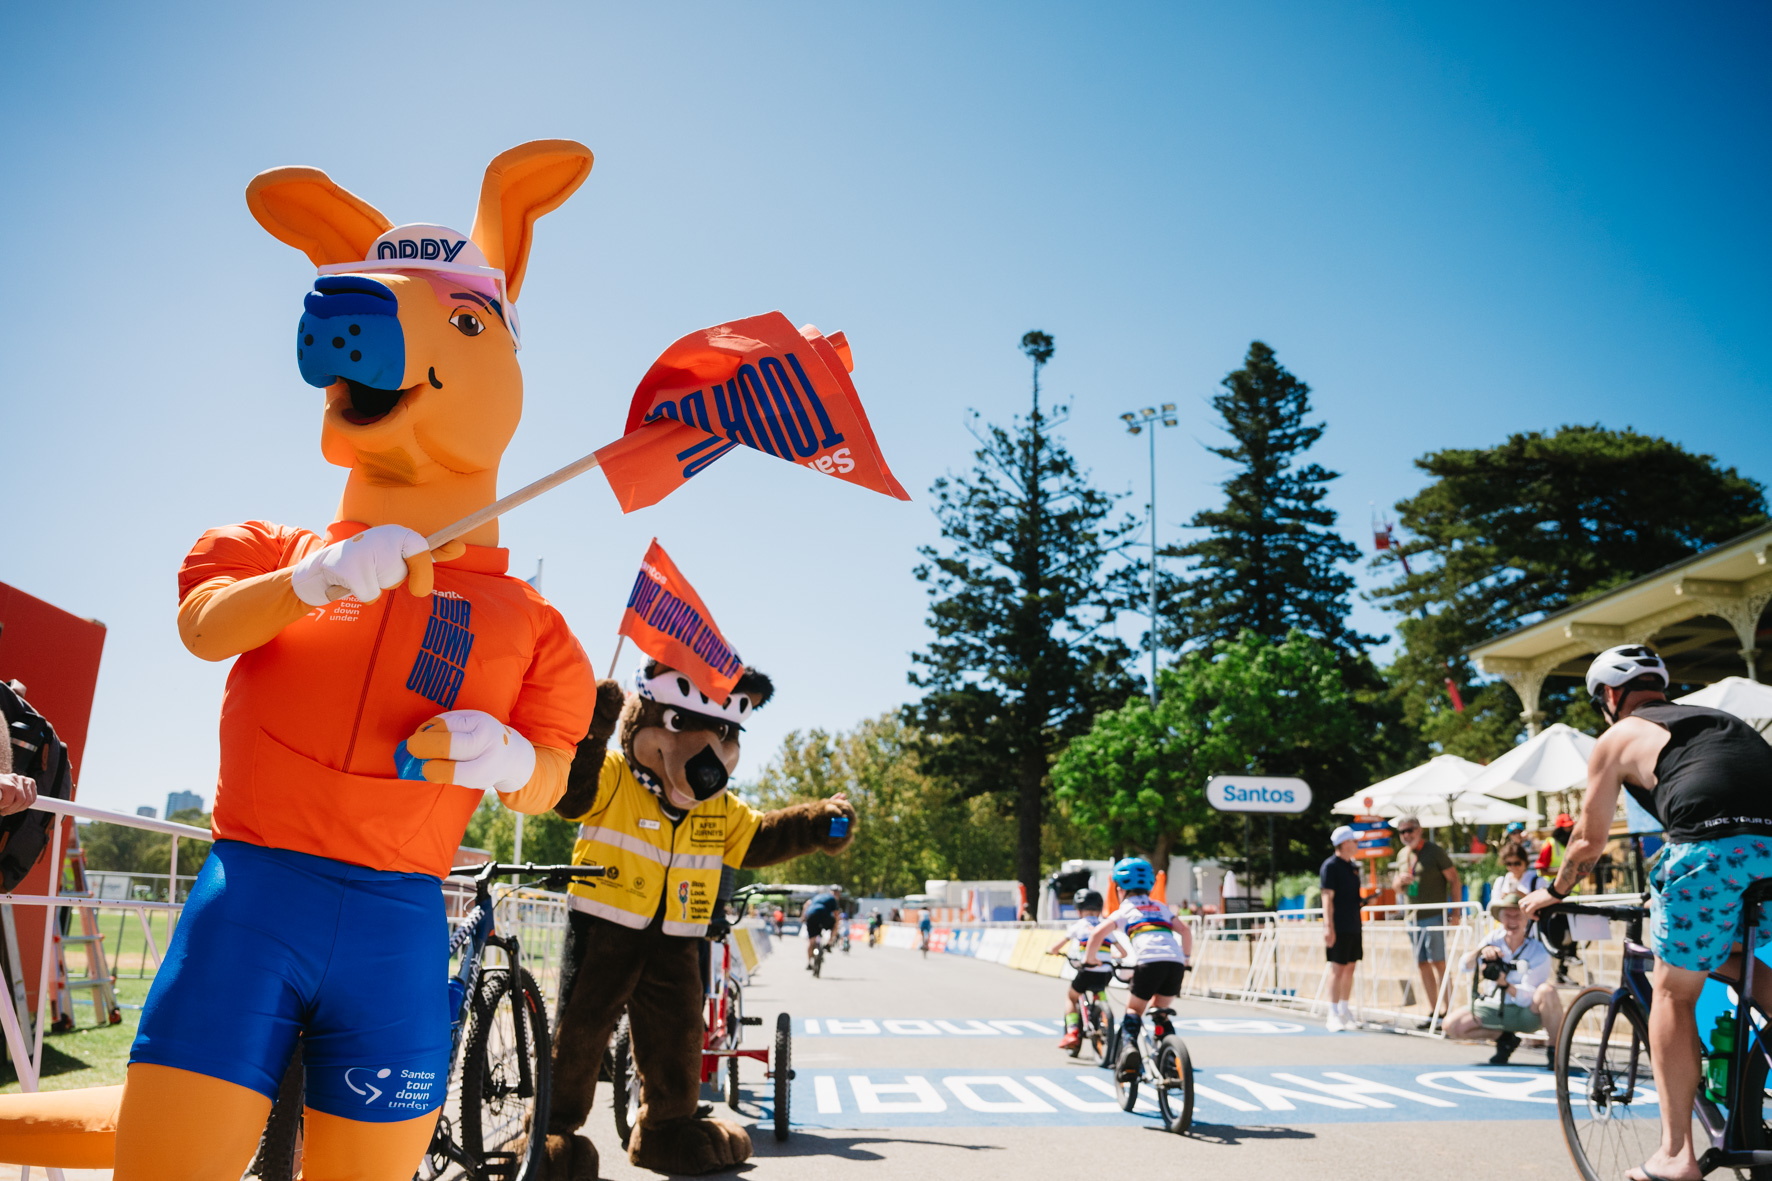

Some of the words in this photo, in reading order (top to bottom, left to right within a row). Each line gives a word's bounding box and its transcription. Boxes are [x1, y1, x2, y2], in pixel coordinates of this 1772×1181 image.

[340, 601, 363, 609] tour
[333, 607, 360, 616] down
[433, 594, 472, 630] TOUR
[329, 614, 358, 622] under
[648, 590, 704, 647] DOWN
[693, 624, 740, 680] UNDER
[421, 615, 475, 669] DOWN
[406, 649, 465, 711] UNDER
[1223, 784, 1295, 804] Santos
[1704, 817, 1730, 828] RIDE
[1732, 815, 1763, 825] YOUR
[463, 953, 481, 1012] POLICE
[400, 1069, 436, 1080] Santos
[406, 1080, 433, 1090] tour
[395, 1089, 430, 1100] down
[388, 1101, 429, 1110] under
